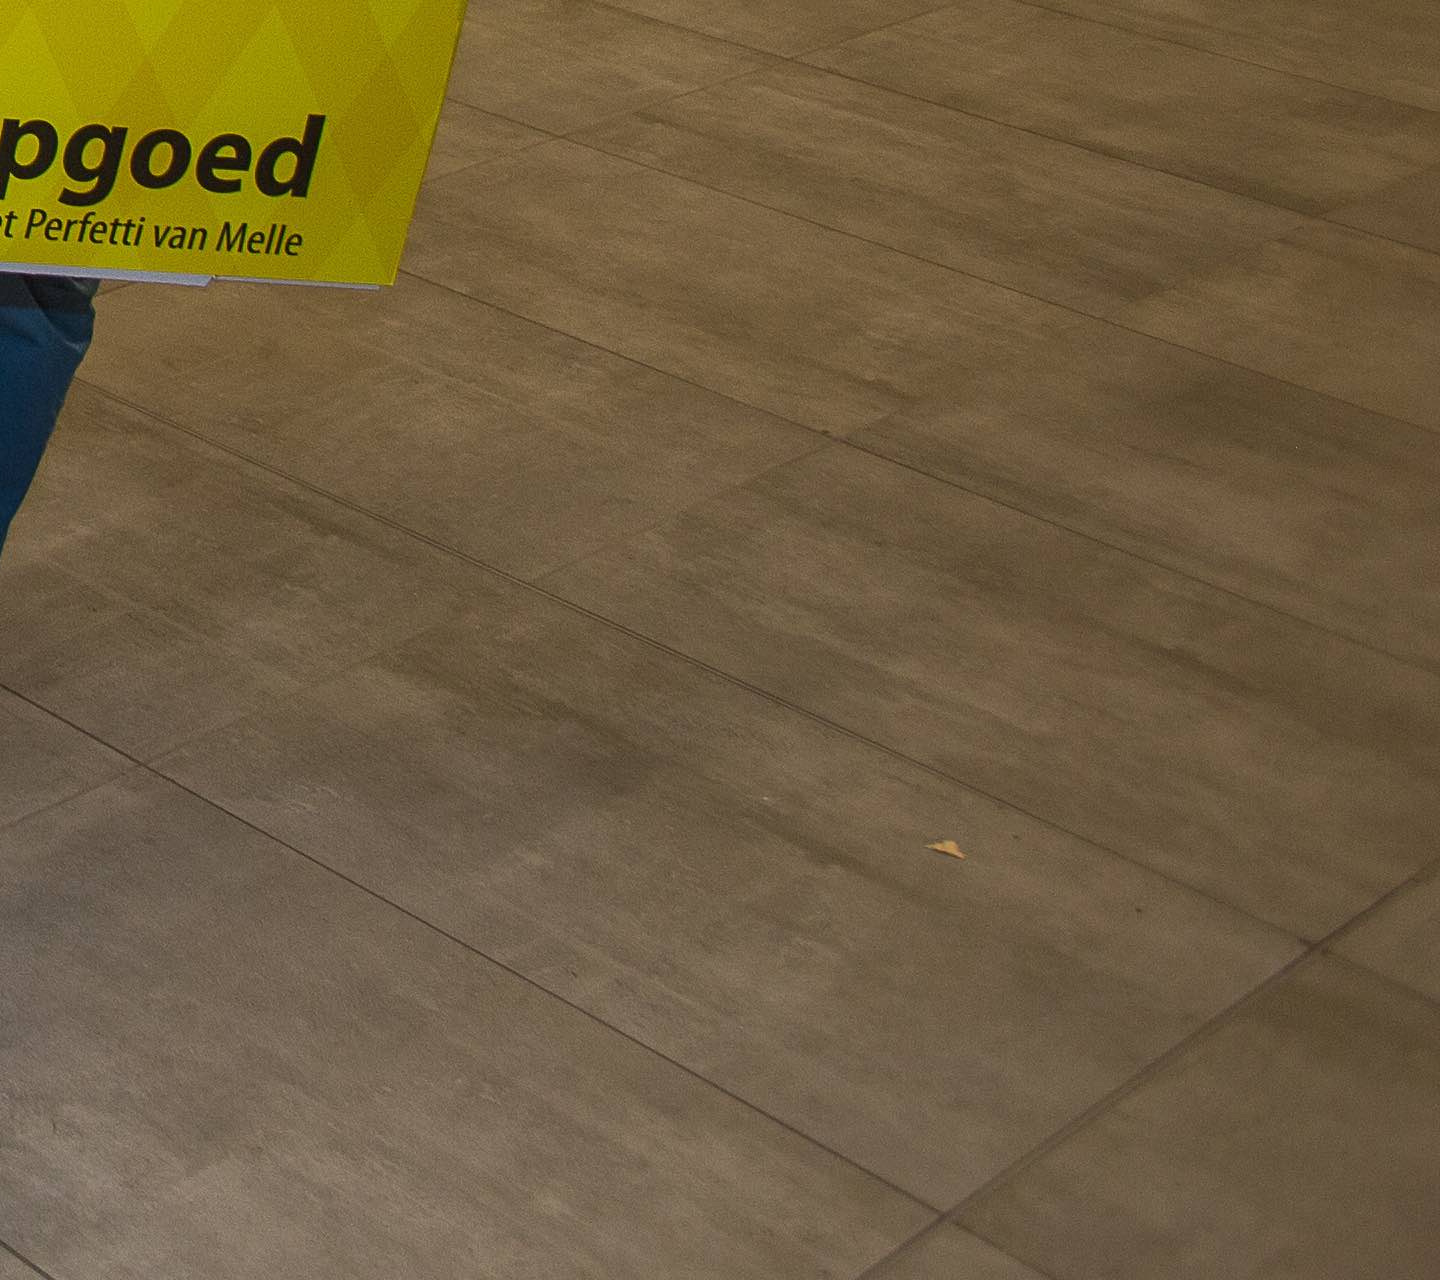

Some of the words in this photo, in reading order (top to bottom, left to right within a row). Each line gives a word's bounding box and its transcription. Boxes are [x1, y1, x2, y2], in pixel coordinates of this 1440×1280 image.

[25, 212, 146, 248] Perfetti
[154, 224, 208, 252] van
[215, 220, 304, 258] Melle
